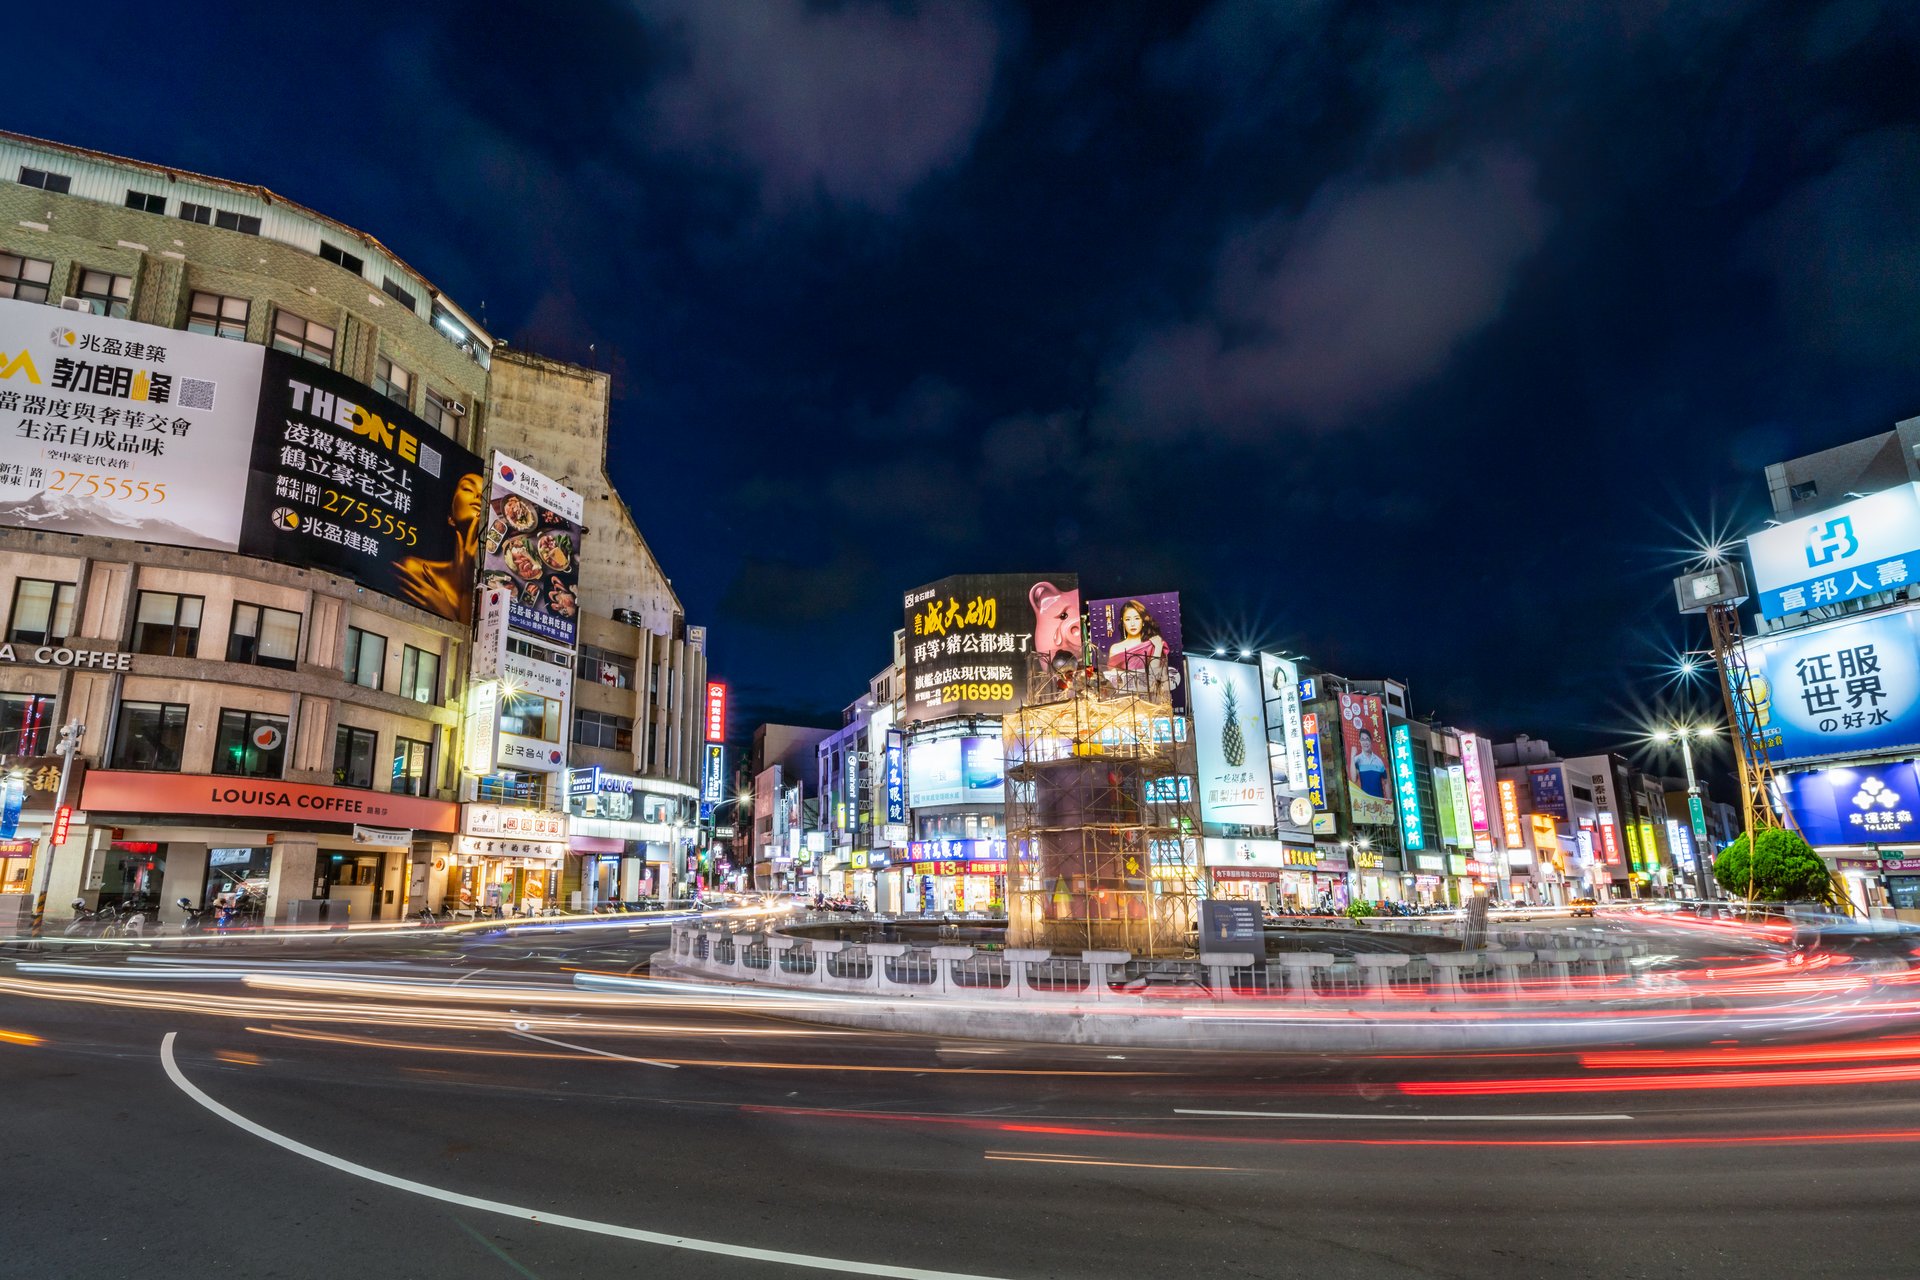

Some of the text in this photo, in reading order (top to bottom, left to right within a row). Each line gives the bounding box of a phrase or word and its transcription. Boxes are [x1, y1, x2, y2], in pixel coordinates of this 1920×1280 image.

[79, 333, 168, 364] 兆盈建築
[0, 389, 192, 438] 當器度與奢華交會
[16, 418, 166, 457] 生活自成品味
[47, 449, 130, 470] 空中豪宅代表作
[48, 469, 167, 505] 2755555
[280, 445, 412, 515] 鶴立豪宅之群
[301, 516, 380, 557] 兆盈建築
[322, 490, 418, 547] 2755555
[1779, 559, 1909, 612] 富邦人壽
[34, 647, 132, 671] COFFEE
[1795, 643, 1882, 687] 征服
[942, 683, 1013, 704] 2316999
[1800, 675, 1888, 717] 世界
[1819, 707, 1893, 734] の好水
[504, 743, 545, 761] 한국음식
[212, 788, 291, 807] LOUISA
[297, 795, 363, 814] COFFEE
[889, 747, 903, 820] 寶島眼鏡
